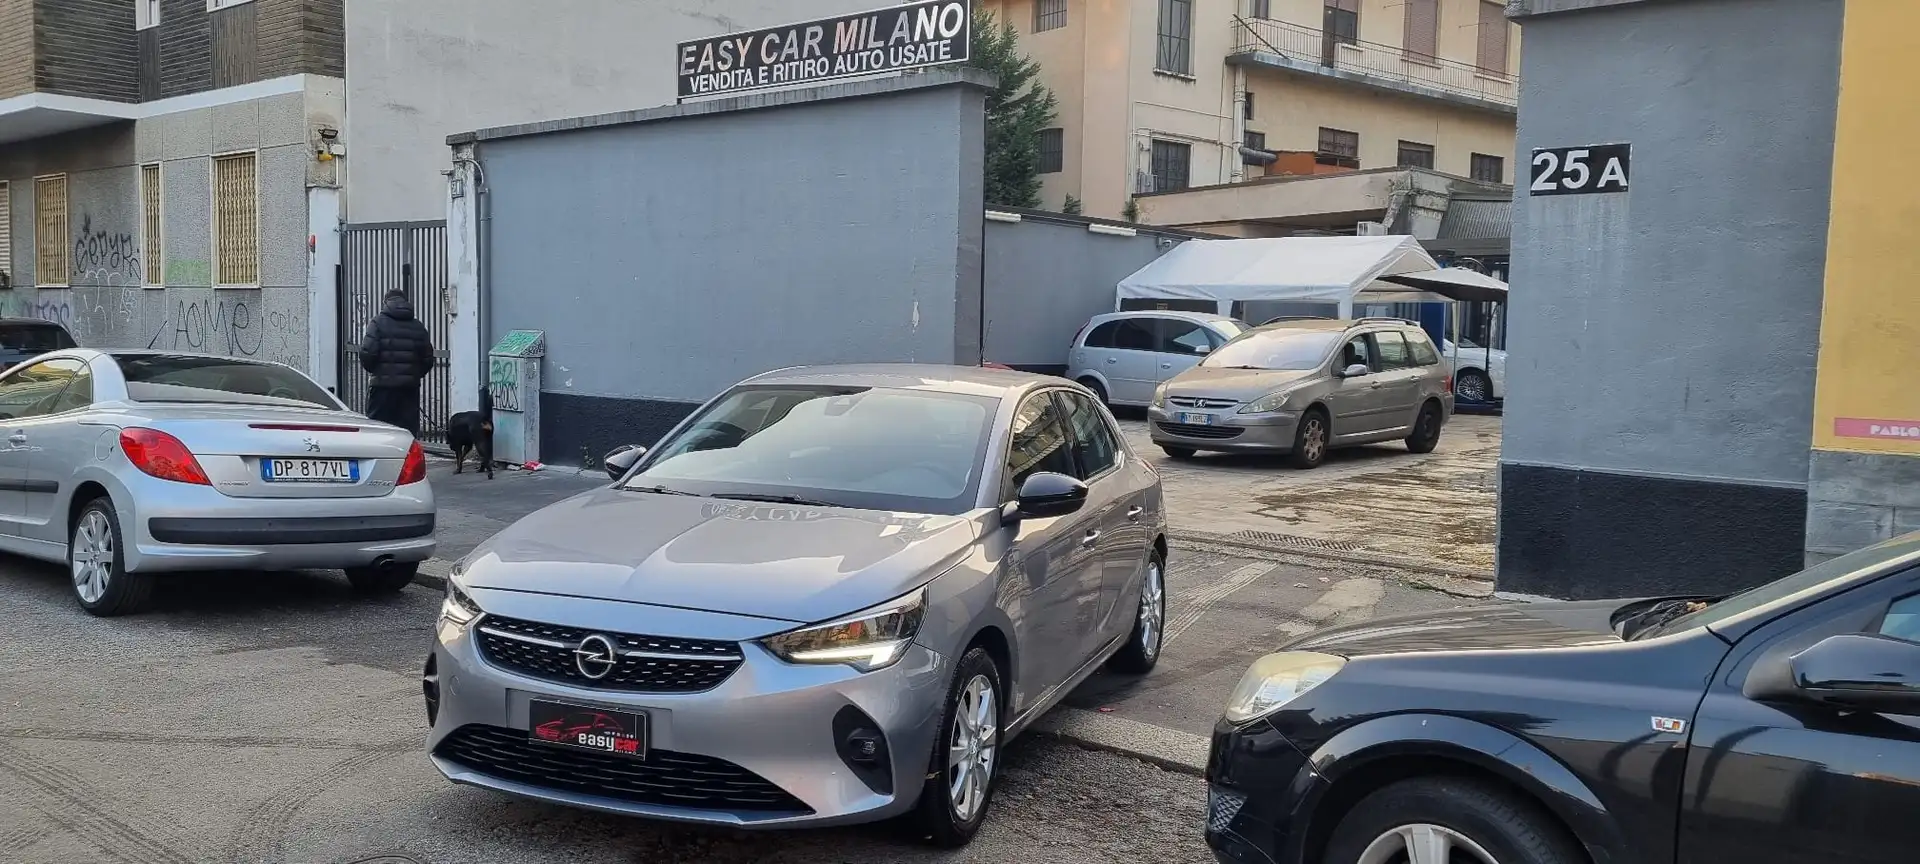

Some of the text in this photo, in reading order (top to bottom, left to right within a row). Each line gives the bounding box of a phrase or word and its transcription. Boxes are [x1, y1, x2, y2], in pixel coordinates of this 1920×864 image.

[680, 2, 964, 76] EASY CAR MILANO
[690, 40, 952, 93] VENDITA E RITIRO AUTO USATE
[274, 460, 348, 478] DP 817VL
